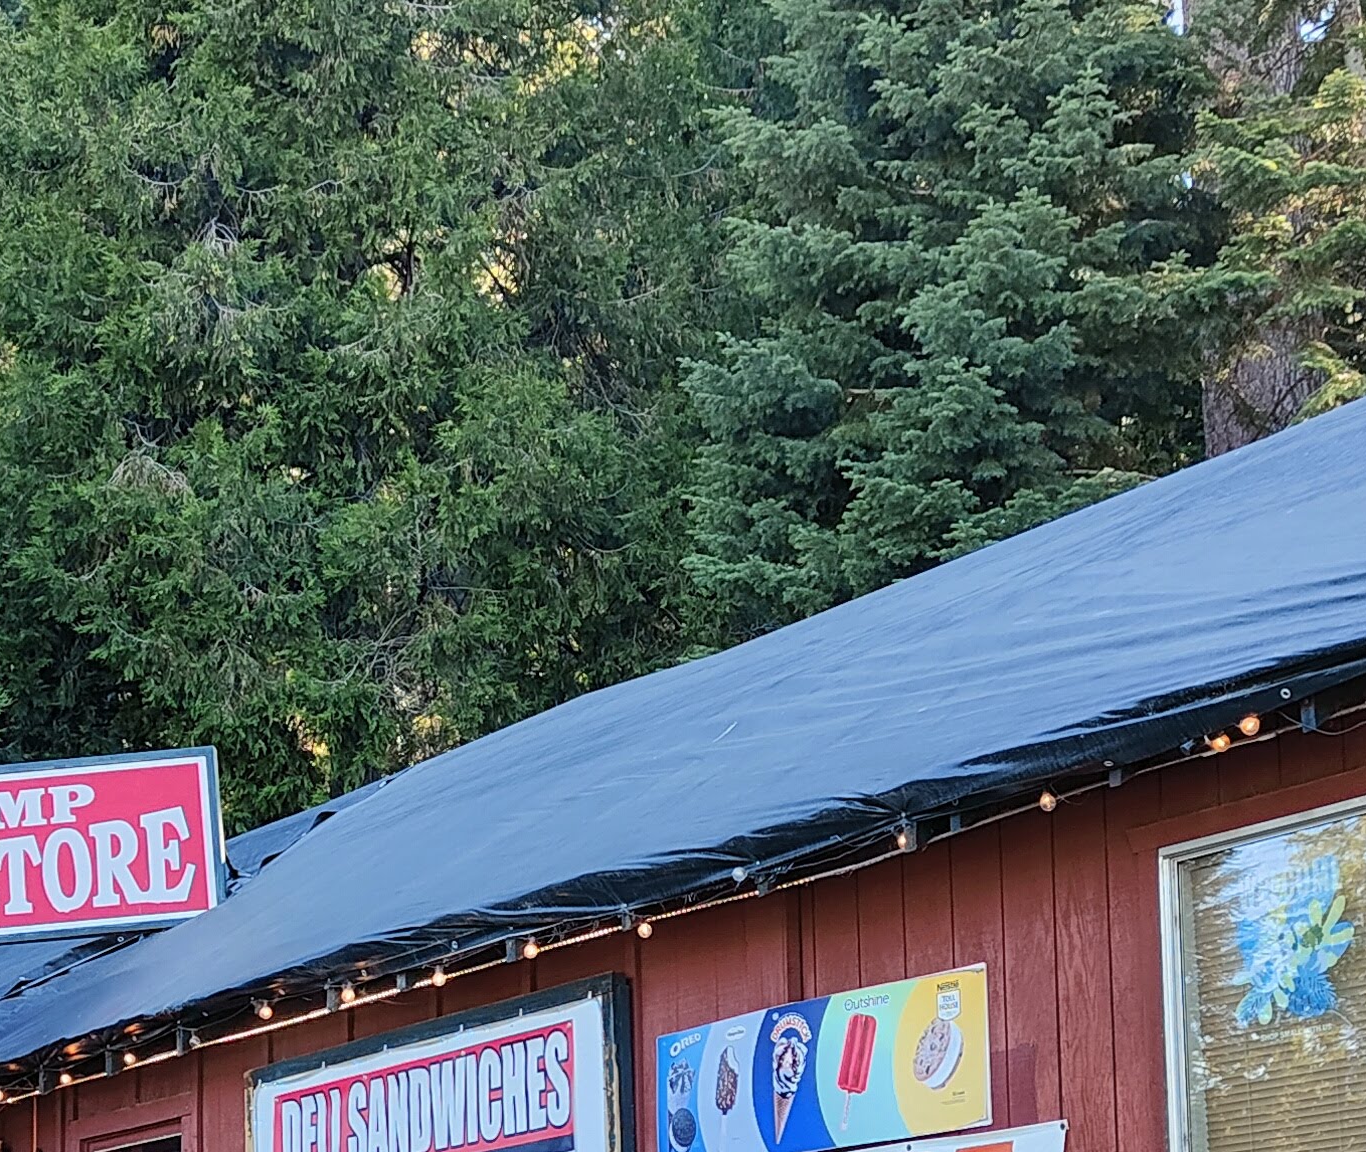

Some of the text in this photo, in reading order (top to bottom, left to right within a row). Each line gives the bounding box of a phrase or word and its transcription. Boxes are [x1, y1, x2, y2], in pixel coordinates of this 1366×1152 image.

[844, 993, 890, 1012] Outshine
[770, 1013, 813, 1044] DRUMSTICK
[670, 1032, 702, 1058] OREO
